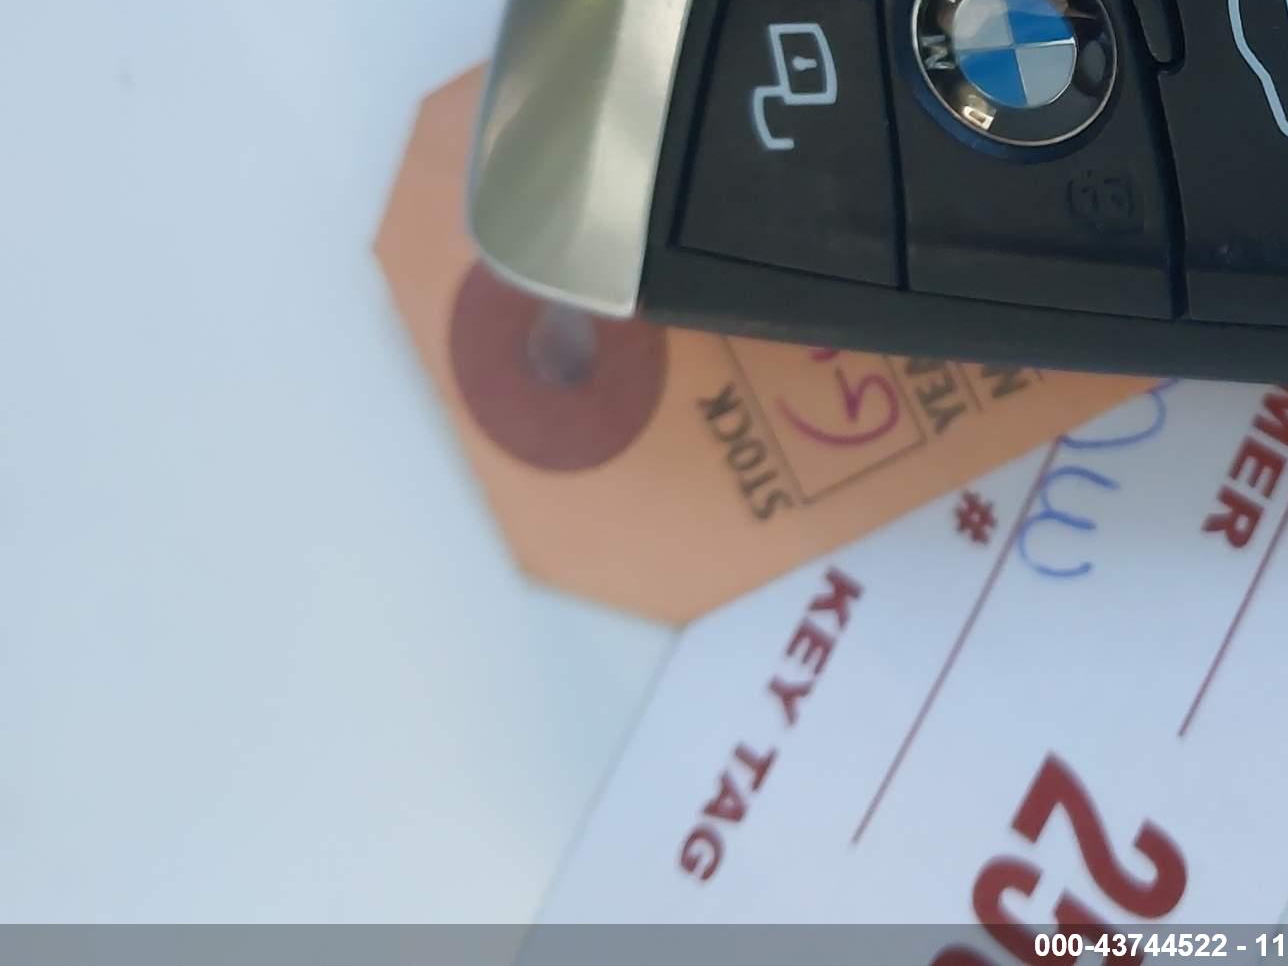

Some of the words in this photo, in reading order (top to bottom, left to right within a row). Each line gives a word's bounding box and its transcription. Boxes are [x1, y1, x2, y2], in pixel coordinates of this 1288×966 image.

[697, 382, 795, 522] STOCK
[768, 566, 864, 725] KEY
[680, 741, 777, 881] TAG
[929, 751, 1187, 966] 25
